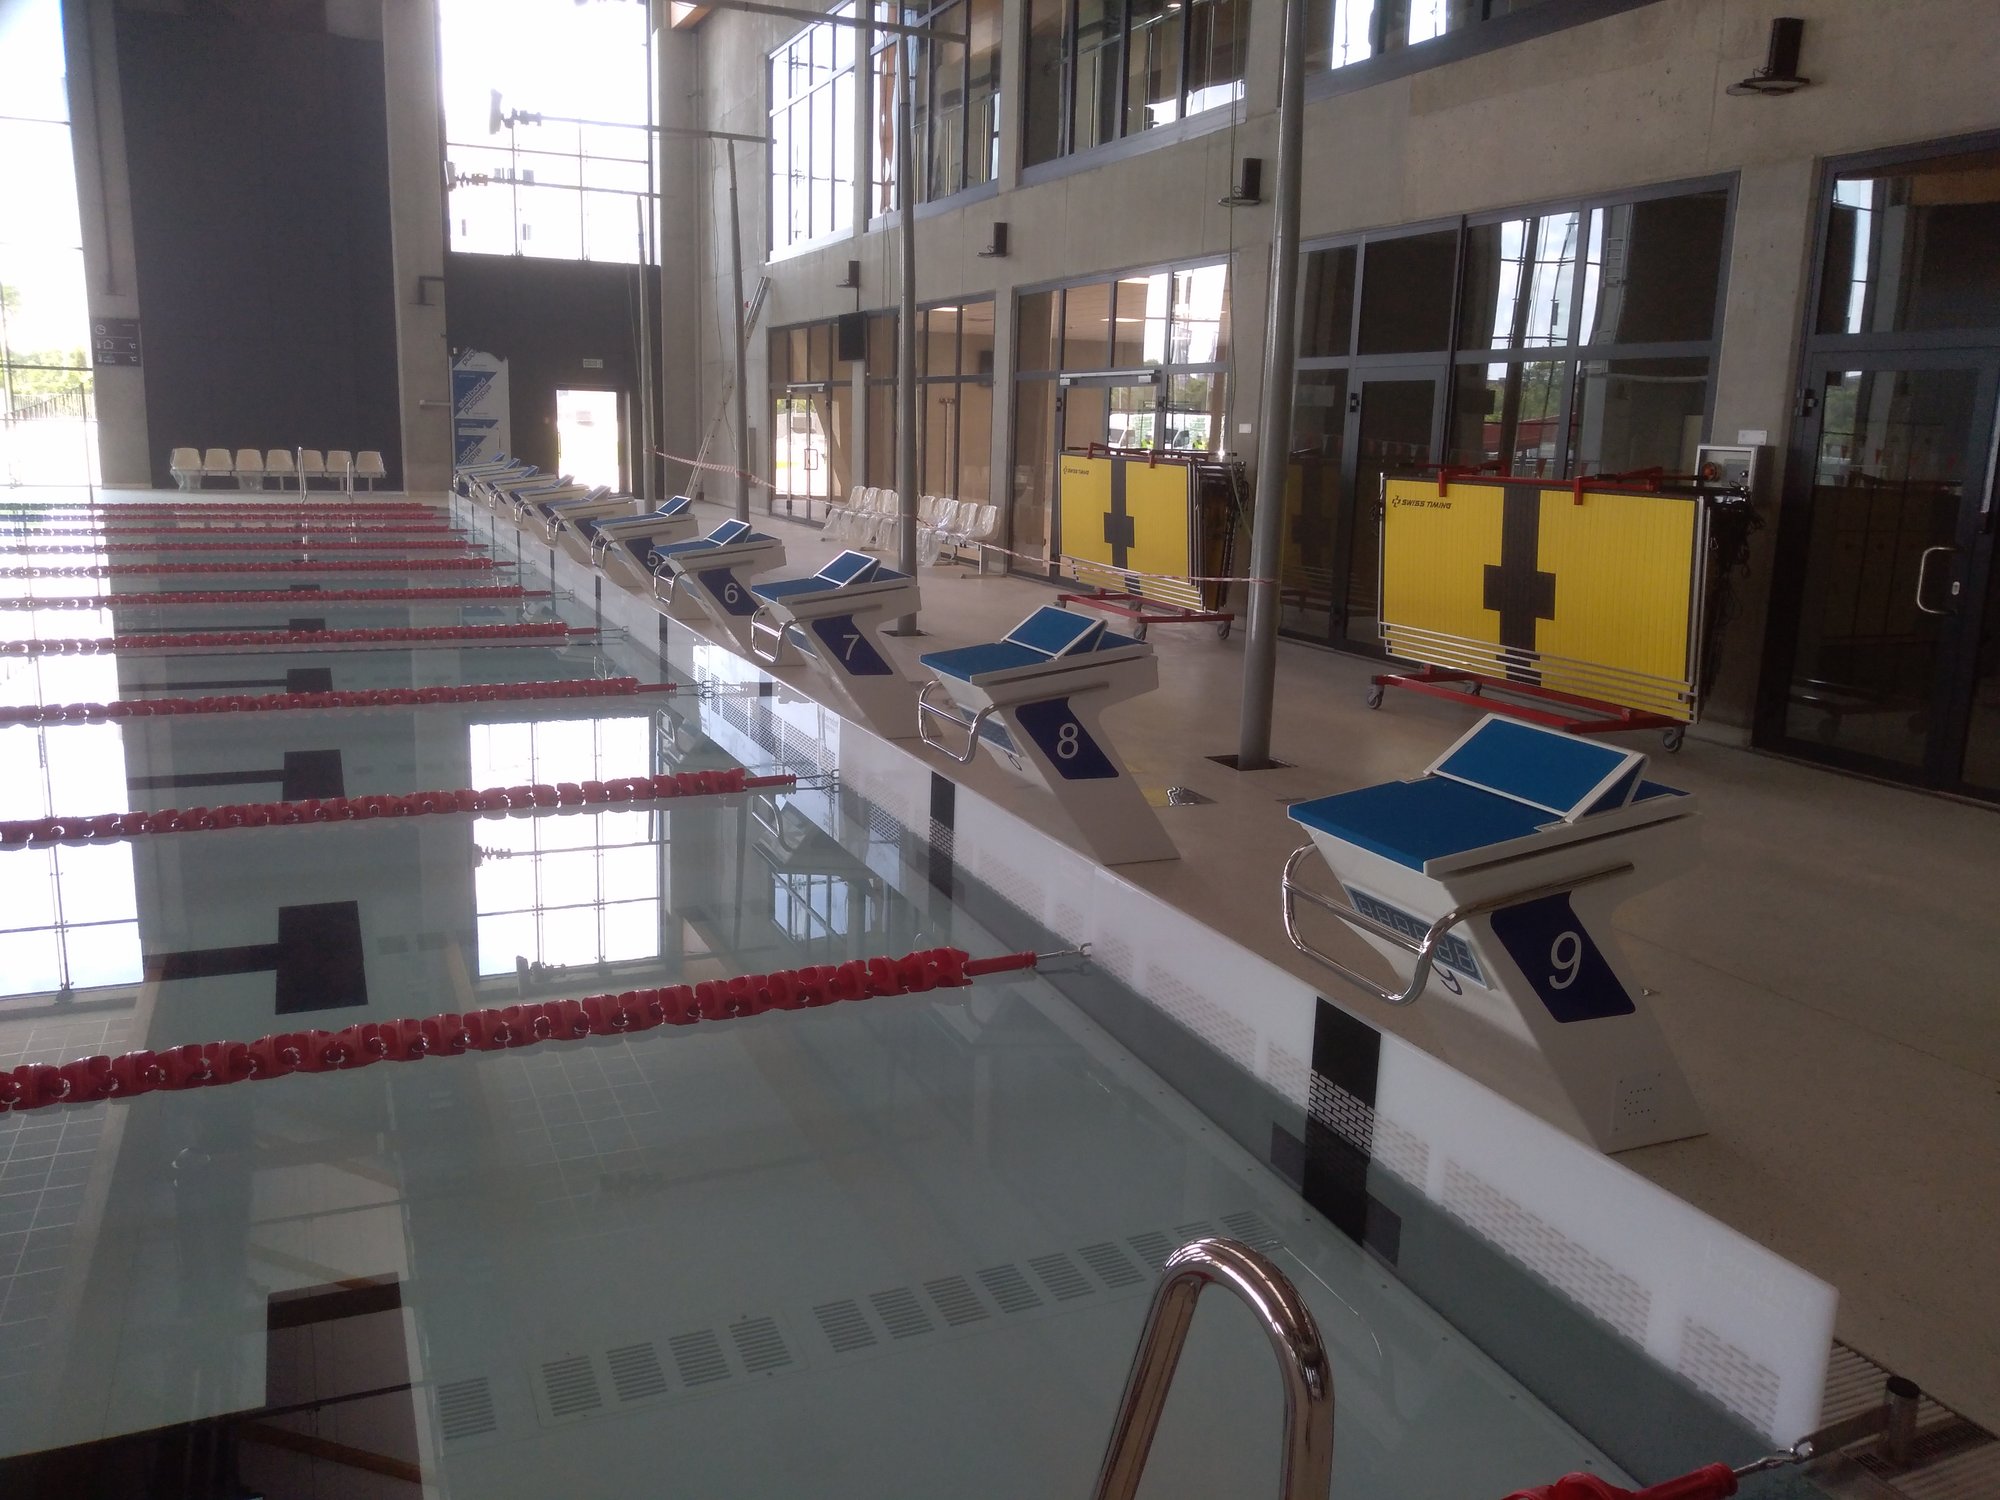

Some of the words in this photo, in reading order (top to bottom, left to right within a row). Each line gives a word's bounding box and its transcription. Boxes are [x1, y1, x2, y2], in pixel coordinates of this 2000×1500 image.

[1401, 499, 1425, 507] SWISS
[1427, 501, 1452, 509] TIMING
[646, 550, 659, 567] 5
[724, 584, 738, 604] 6
[842, 634, 860, 661] 7
[1057, 722, 1079, 759] 8
[1548, 931, 1582, 989] 9
